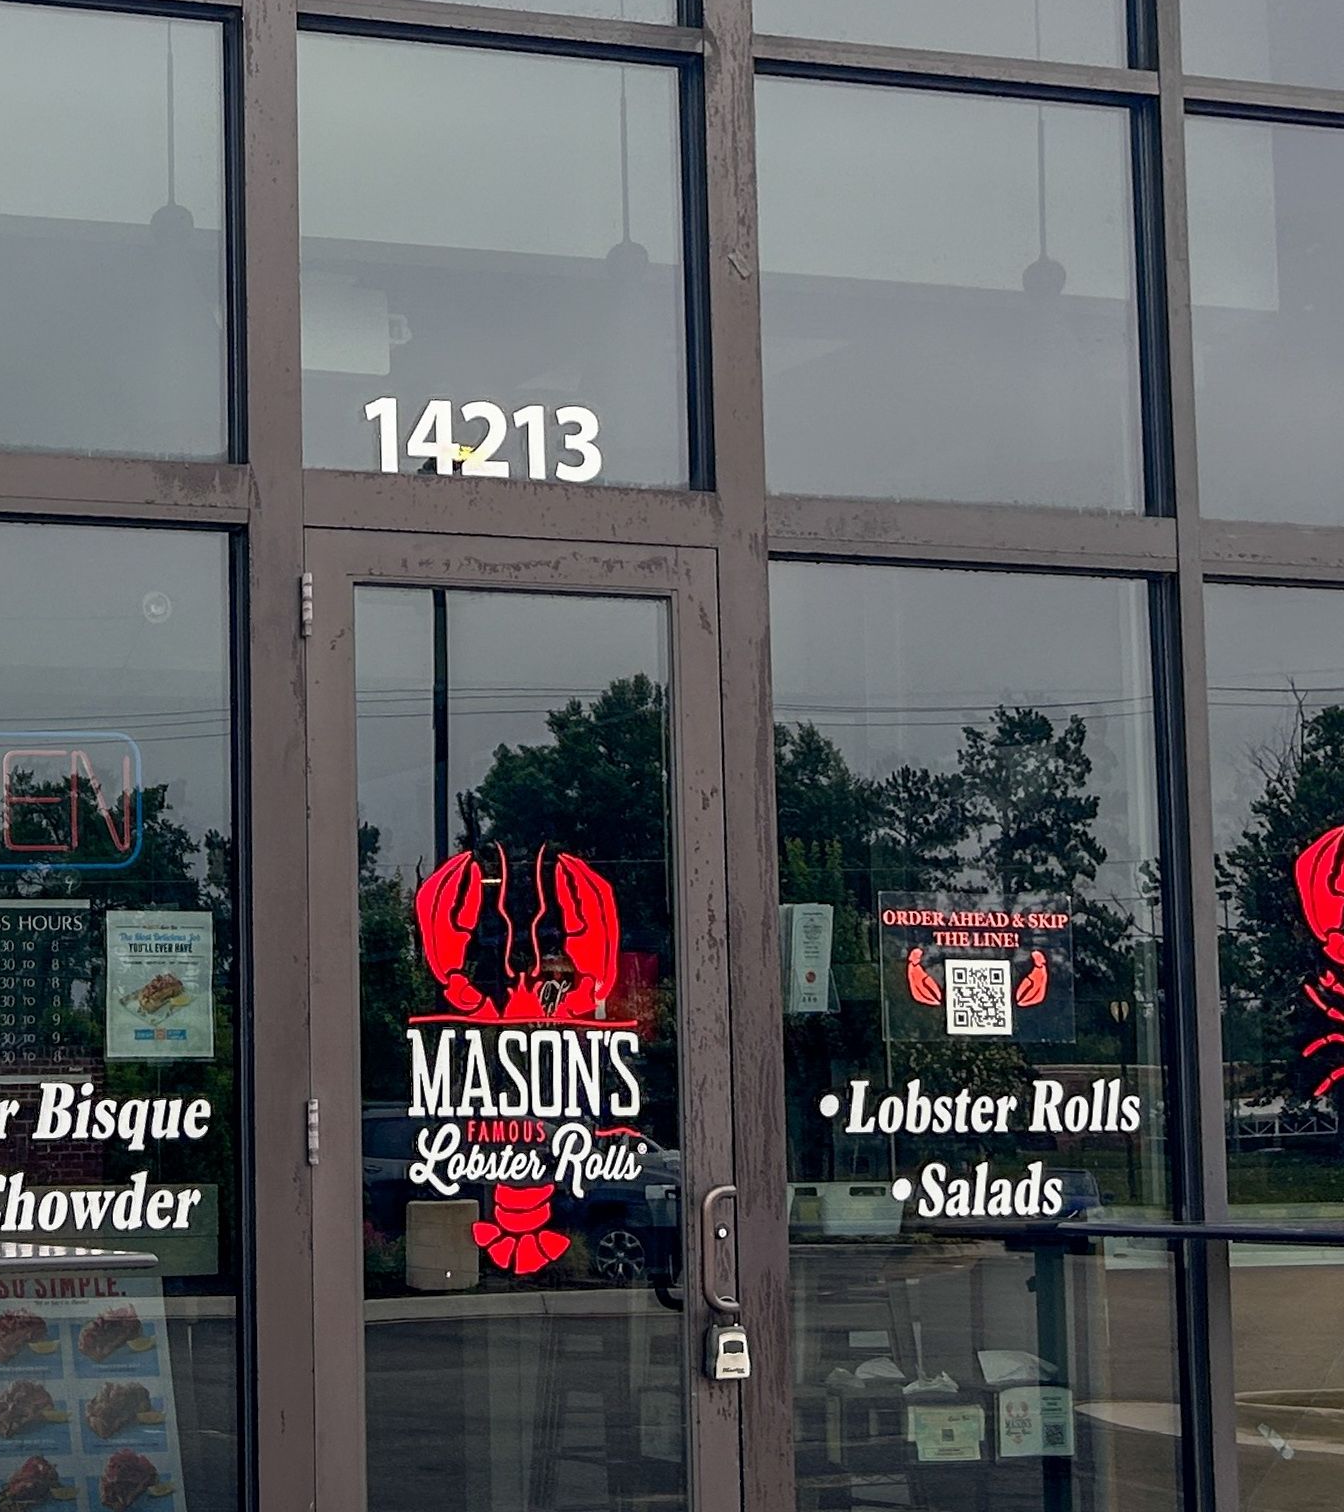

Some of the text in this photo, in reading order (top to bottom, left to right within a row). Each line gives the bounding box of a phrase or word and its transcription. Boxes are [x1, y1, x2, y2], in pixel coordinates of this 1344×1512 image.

[364, 396, 603, 482] 14213
[18, 915, 83, 931] HOURS
[882, 909, 1069, 929] ORDER AHEAD & SKIP
[51, 940, 59, 952] 8
[933, 931, 1020, 947] THE LINE!
[51, 959, 60, 970] 8
[51, 977, 60, 989] 8
[53, 996, 61, 1007] 8
[52, 1014, 61, 1026] 9
[52, 1033, 61, 1045] 9
[53, 1051, 62, 1064] 8
[407, 1029, 641, 1117] MASON'S
[845, 1079, 1141, 1134] Lobster Rolls
[32, 1081, 212, 1151] Bisque
[467, 1120, 546, 1142] FAMOUS
[409, 1122, 643, 1198] Lobster Rolls
[918, 1161, 1065, 1218] Salads
